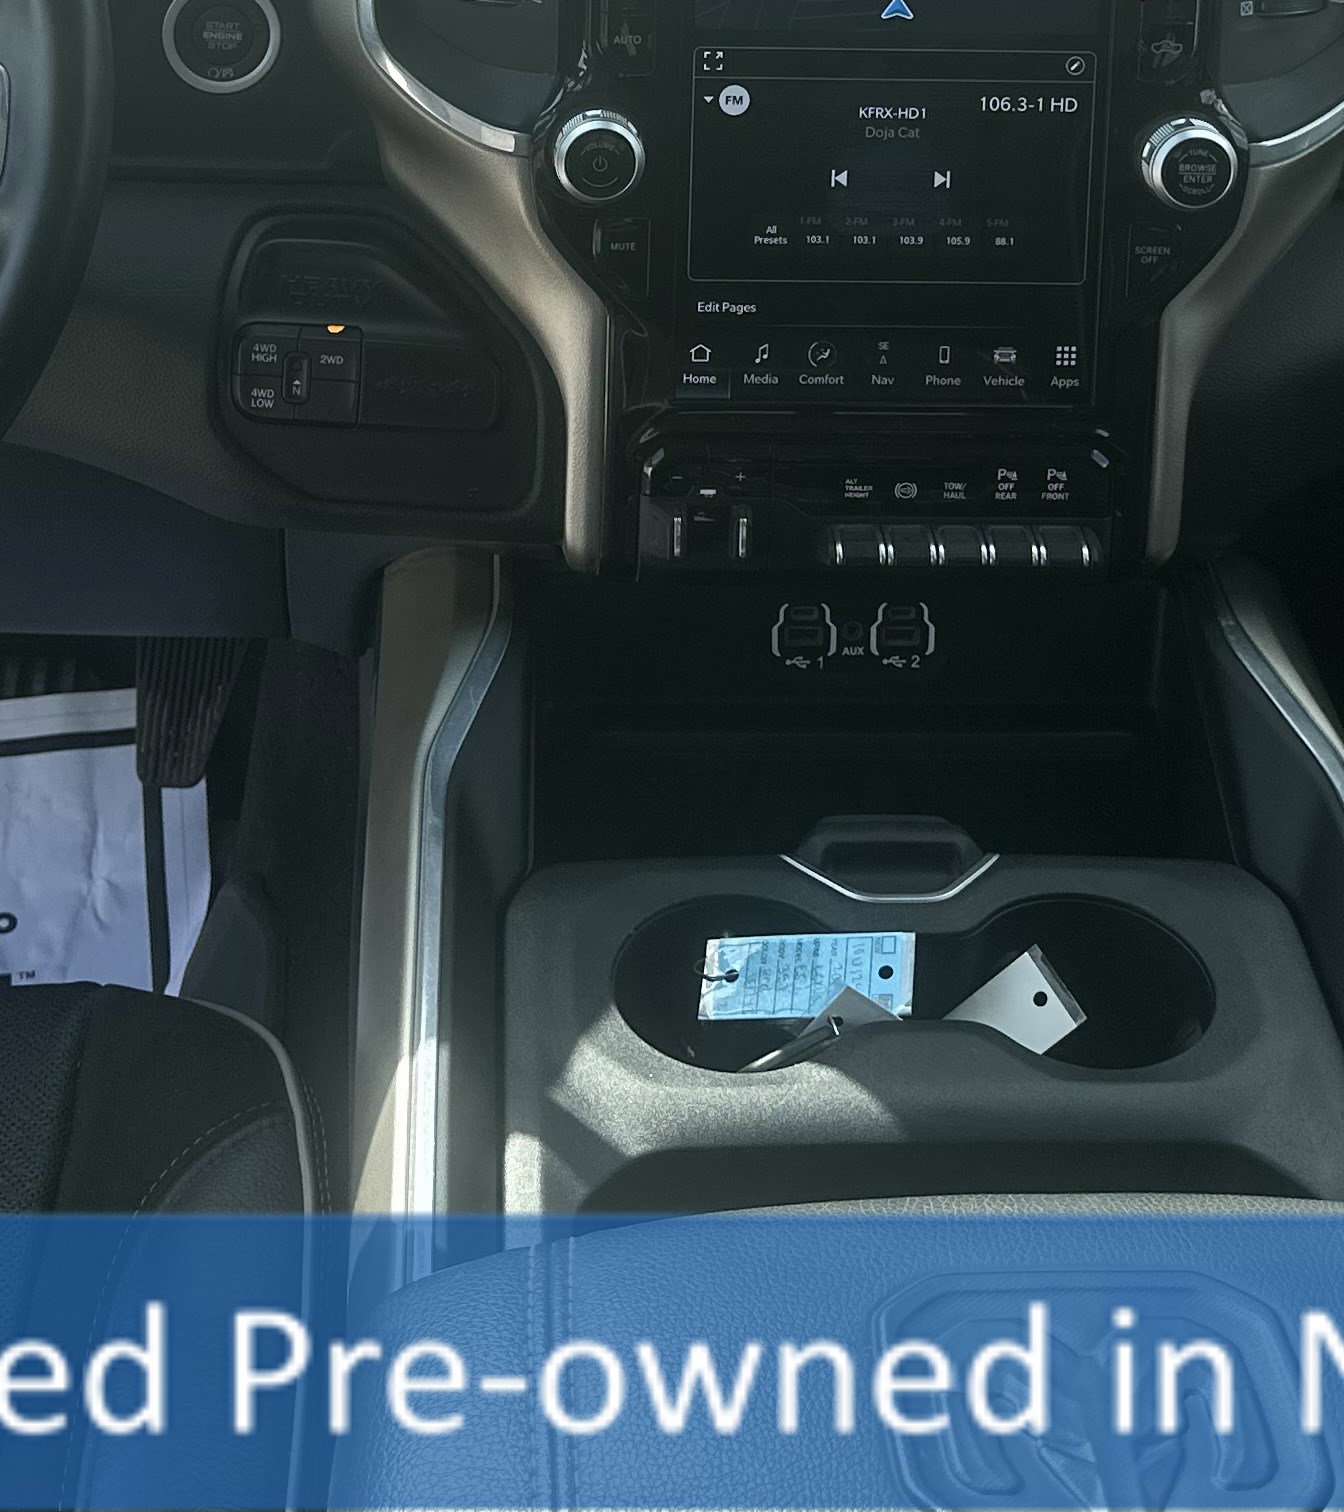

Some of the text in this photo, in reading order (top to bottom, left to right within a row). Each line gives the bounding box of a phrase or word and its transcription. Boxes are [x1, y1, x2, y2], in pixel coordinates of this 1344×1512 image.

[206, 21, 241, 29] START
[202, 31, 243, 40] ENGINE
[614, 35, 642, 45] AUTO
[725, 96, 744, 105] FM
[980, 97, 1078, 112] 106.3-1 HD
[865, 126, 920, 140] Doja Cat
[1179, 163, 1216, 171] BROWSE
[766, 226, 777, 235] All
[754, 236, 788, 245] Presets
[806, 236, 830, 244] 103.1
[853, 236, 876, 245] 103.1
[899, 236, 924, 245] 103.9
[946, 237, 971, 246] 105.9
[610, 242, 636, 251] MUTE
[1135, 247, 1171, 255] SCREEN
[1141, 256, 1158, 264] OFF
[697, 301, 757, 315] Edit Pages
[252, 343, 277, 352] 4WD
[251, 353, 277, 363] HIGH
[320, 354, 344, 365] 2WD
[683, 374, 717, 385] Home
[743, 374, 779, 385] Media
[799, 374, 844, 385] Comfort
[871, 375, 895, 385] Nav
[925, 375, 961, 386] Phone
[983, 375, 1025, 386] Vehicle
[1050, 376, 1080, 388] Apps
[251, 388, 275, 398] 4WD
[292, 386, 301, 396] N
[251, 398, 274, 408] LOW
[998, 483, 1014, 491] OFF
[1048, 483, 1064, 491] OFF
[944, 491, 966, 499] HAUL
[995, 492, 1017, 500] REAR
[1042, 492, 1070, 500] FRONT
[842, 647, 864, 656] AUX
[817, 656, 824, 669] 1
[911, 655, 921, 669] 2
